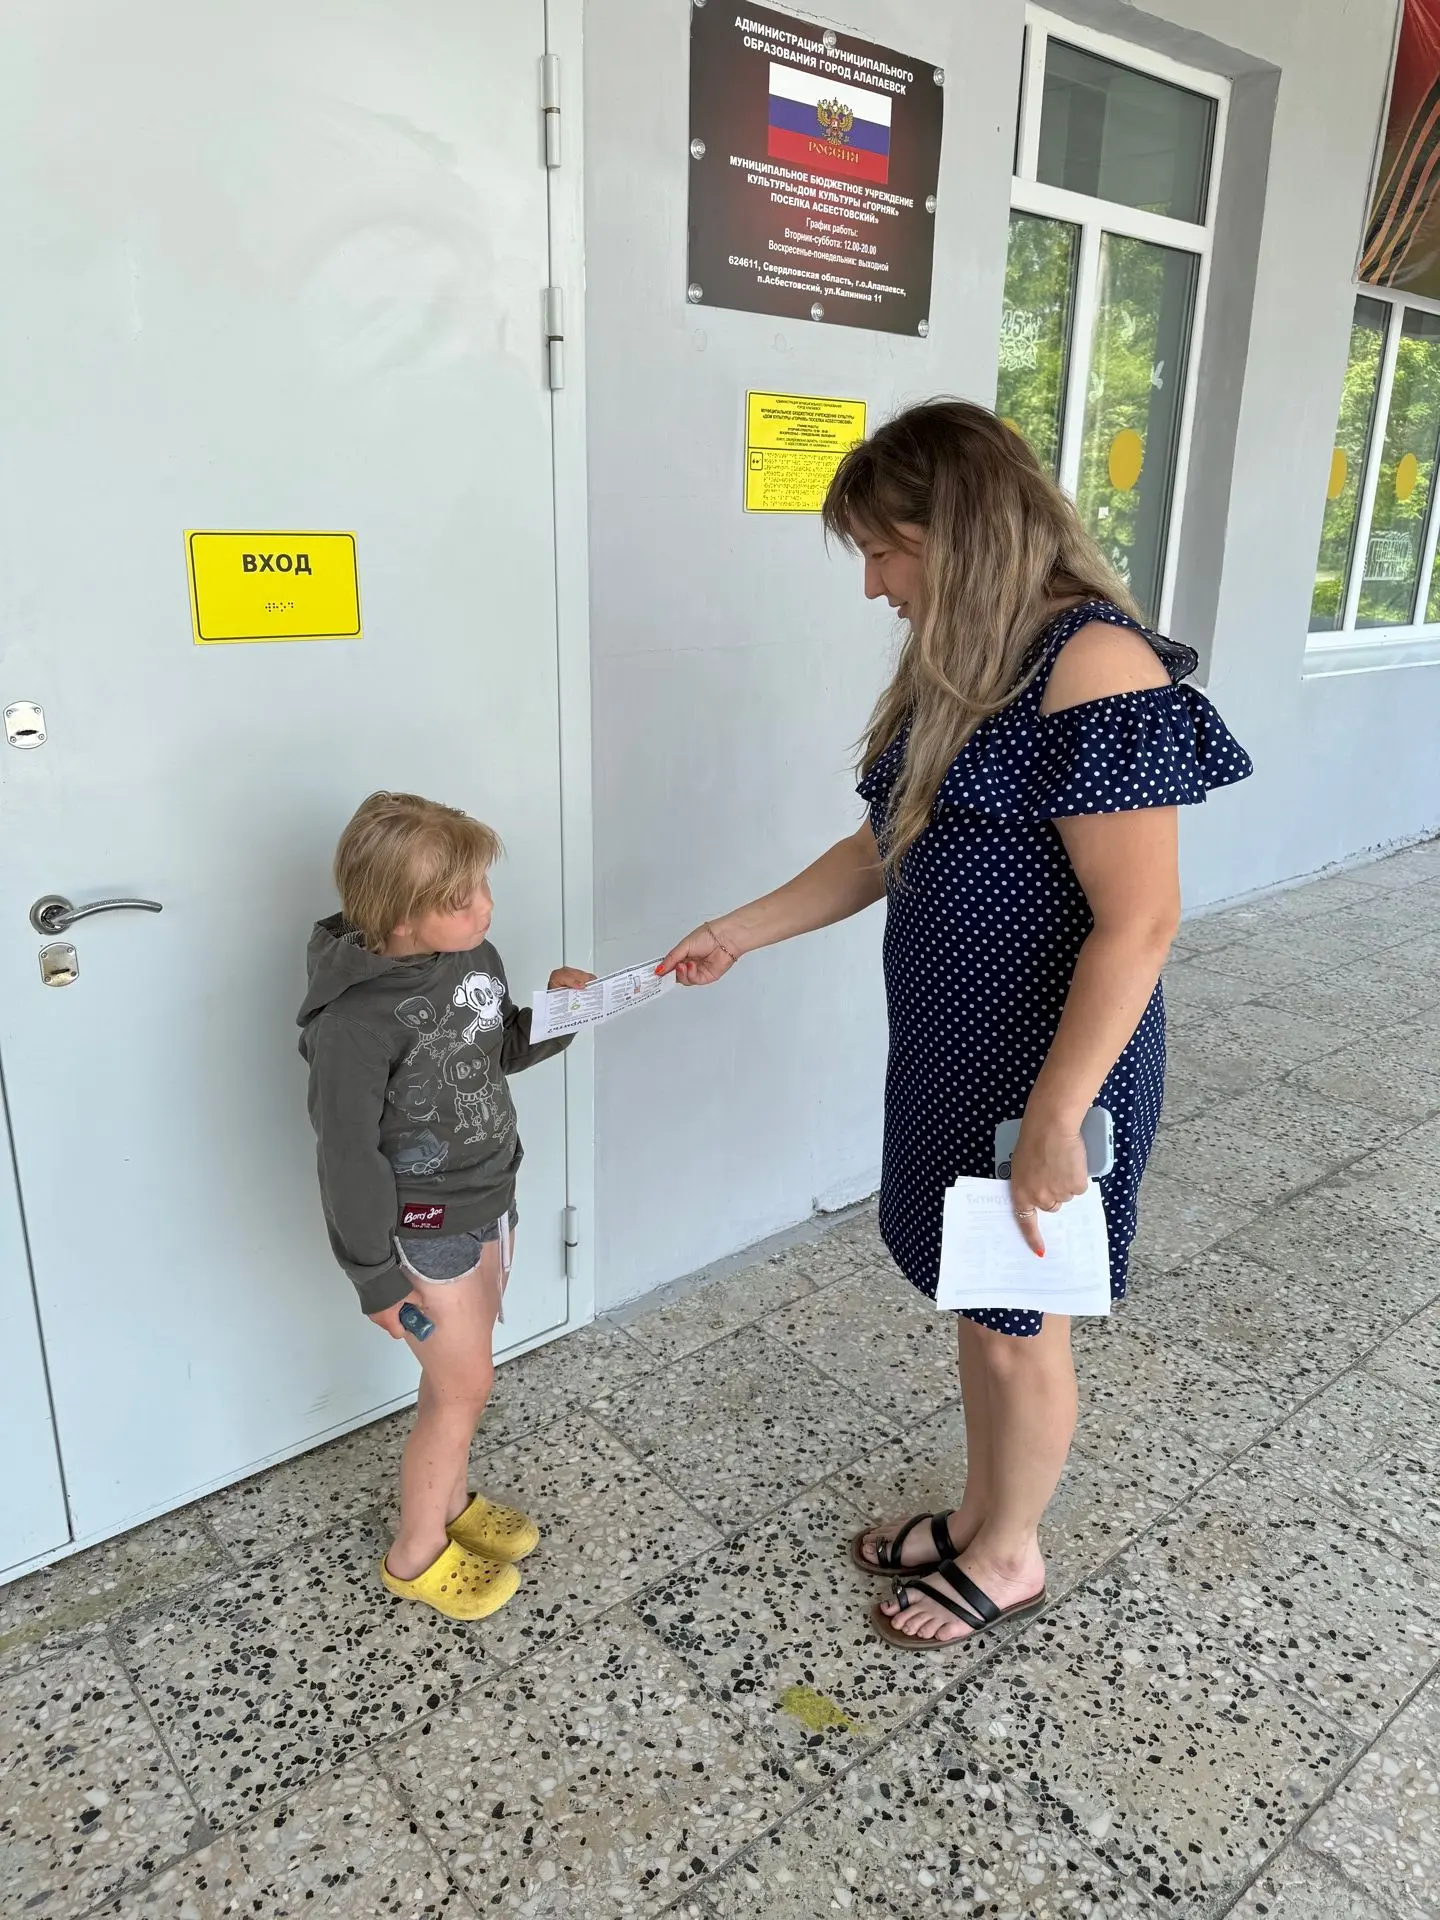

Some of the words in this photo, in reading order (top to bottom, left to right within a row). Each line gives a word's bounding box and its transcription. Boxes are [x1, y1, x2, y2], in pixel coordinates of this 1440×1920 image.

[734, 16, 825, 55] АДМИНИСТРАЦИЯ
[826, 47, 914, 83] МУНИЦИПАЛЬНОГО
[743, 35, 817, 68] ОБРАЗОВАНИЯ
[819, 59, 851, 80] ГОРОД
[853, 70, 906, 95] АЛАПАЕВСК
[808, 141, 860, 164] РОССИЯ
[729, 155, 809, 183] МУНИЦИПАЛЬНОЕ
[810, 174, 864, 195] БЮДЖЕТНОЕ
[864, 187, 914, 208] УЧРЕЖДЕНИЕ
[770, 192, 811, 210] ПОСЕЛКА
[812, 200, 880, 224] АСБЕСТОВСКИЙ»
[818, 189, 861, 207] КУЛЬТУРЫ
[862, 201, 900, 217] «ГОРНЯК»
[784, 227, 843, 249] Вторник-суббота:
[843, 240, 877, 255] 12.00-20.00
[806, 217, 832, 231] График
[832, 224, 859, 238] работы:
[768, 239, 857, 266] Воскресенье-понедельник:
[858, 258, 890, 272] выходной
[728, 255, 761, 271] 624611,
[763, 261, 820, 280] Свердловская
[821, 272, 854, 287] область,
[757, 275, 823, 295] п.Асбестовский,
[824, 286, 873, 301] ул.Калинина
[873, 293, 882, 303] 11
[242, 553, 312, 576] ВХОД
